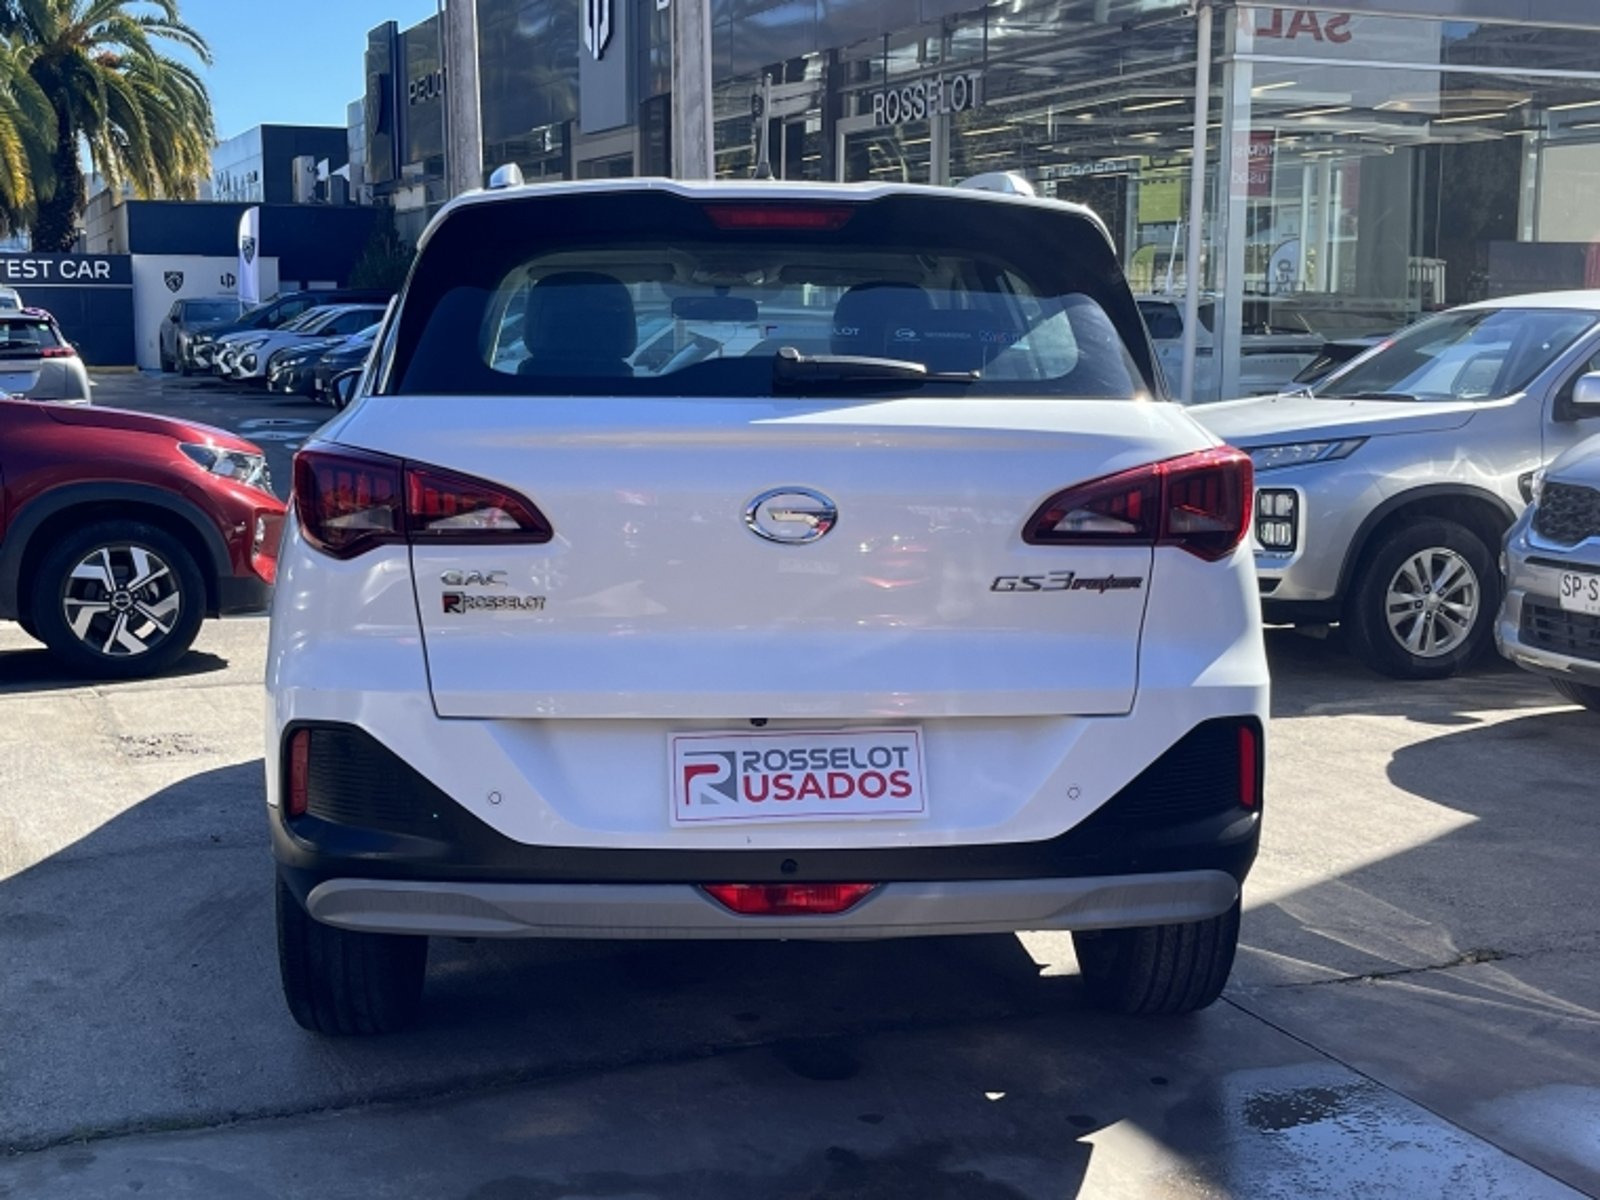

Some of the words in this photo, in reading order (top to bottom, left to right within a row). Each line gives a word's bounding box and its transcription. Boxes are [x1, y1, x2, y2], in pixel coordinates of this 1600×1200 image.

[873, 73, 982, 127] ROSSELOT
[60, 260, 110, 279] CAR
[440, 570, 508, 586] GAC
[990, 571, 1075, 592] GS3
[465, 595, 546, 611] ROSSELOT
[742, 746, 909, 773] ROSSELOT
[743, 770, 912, 803] USADOS
